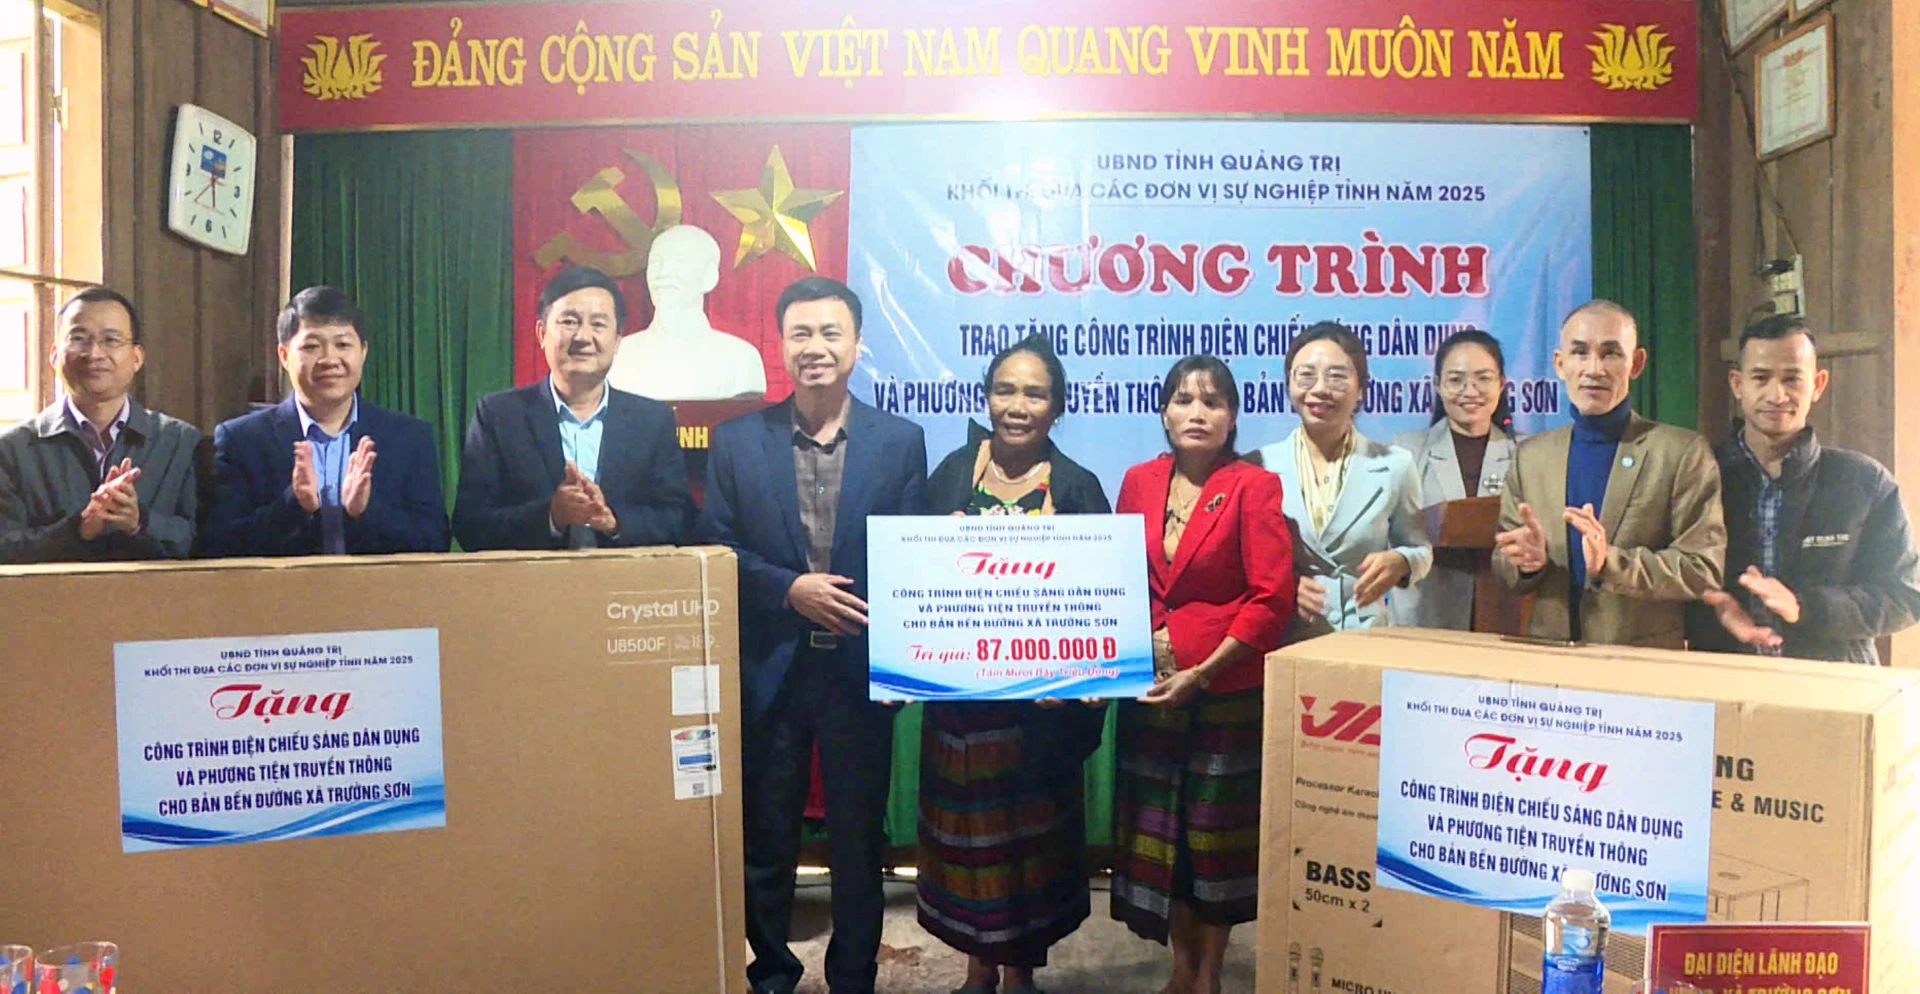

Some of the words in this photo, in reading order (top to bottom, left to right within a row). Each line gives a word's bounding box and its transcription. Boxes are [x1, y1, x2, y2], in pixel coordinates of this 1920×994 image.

[412, 17, 526, 87] ĐẢNG
[540, 20, 657, 95] CỘNG
[672, 9, 760, 80] SẢN
[780, 15, 889, 88] VIỆT
[902, 26, 1001, 77] NAM
[1017, 24, 1172, 78] QUANG
[1185, 26, 1309, 77] VINH
[1326, 15, 1453, 80] MUÔN
[1467, 16, 1564, 80] NĂM
[1097, 155, 1157, 171] UBND
[1164, 151, 1213, 171] TỈNH
[1220, 151, 1303, 171] QUẢNG
[1310, 156, 1340, 175] TRỊ
[1090, 180, 1138, 200] CÁC
[1145, 183, 1191, 200] ĐƠN
[1198, 184, 1217, 204] VỊ
[1224, 183, 1250, 204] SỰ
[1254, 180, 1330, 204] NGHIỆP
[1335, 180, 1380, 201] TỈNH
[1386, 180, 1433, 201] NĂM
[1438, 185, 1486, 201] 2025
[948, 234, 1249, 293] CHƯƠNG
[1268, 230, 1488, 294] TRÌNH
[960, 324, 1010, 356] TRAO
[1075, 317, 1129, 356] CÔNG
[1135, 318, 1194, 356] TRÌNH
[1200, 318, 1248, 363] ĐIỆN
[1378, 318, 1418, 356] DÂN
[874, 376, 898, 412] VÀ
[904, 380, 986, 413] PHƯƠNG
[1244, 372, 1284, 414] BẢN
[1522, 378, 1558, 414] SƠN
[957, 552, 1057, 580] Tặng
[607, 600, 678, 623] Crystal
[220, 650, 250, 660] UBND
[326, 646, 342, 656] TRỊ
[976, 637, 1098, 661] 87.000.000
[1103, 636, 1117, 660] Đ
[210, 684, 354, 724] Tặng
[1478, 696, 1508, 707] UBND
[1586, 707, 1602, 718] TRỊ
[144, 741, 184, 761] CÔNG
[187, 738, 228, 758] TRÌNH
[232, 735, 265, 757] ĐIỆN
[268, 730, 309, 753] CHIẾU
[314, 730, 349, 750] SÁNG
[353, 728, 380, 747] DÂN
[384, 729, 420, 748] DỤNG
[177, 766, 194, 786] VÀ
[199, 766, 256, 785] PHƯƠNG
[259, 761, 290, 782] TIỆN
[294, 755, 345, 778] TRUYỀN
[349, 754, 392, 774] THÔNG
[1464, 732, 1610, 792] Tặng
[159, 799, 187, 816] CHO
[192, 794, 220, 813] BẢN
[224, 789, 252, 811] BẾN
[256, 789, 302, 808] ĐƯỜNG
[306, 786, 324, 804] XÃ
[328, 783, 380, 803] TRƯỜNG
[384, 783, 411, 798] SƠN
[1400, 778, 1436, 801] CÔNG
[1440, 785, 1478, 808] TRÌNH
[1482, 791, 1514, 815] ĐIỆN
[1518, 795, 1559, 820] CHIẾU
[1564, 802, 1602, 827] SÁNG
[1606, 809, 1637, 832] DÂN
[1641, 816, 1683, 839] DỤNG
[1730, 792, 1744, 812] &
[1754, 796, 1824, 824] MUSIC
[1428, 811, 1444, 833] VÀ
[1448, 818, 1502, 842] PHƯƠNG
[1506, 825, 1537, 849] TIỆN
[1541, 832, 1594, 857] TRUYỀN
[1599, 841, 1648, 866] THÔNG
[1306, 860, 1372, 892] BASS
[1410, 841, 1434, 860] CHO
[1438, 843, 1466, 865] BẢN
[1470, 846, 1496, 871] BẾN
[1500, 855, 1547, 880] ĐƯỜNG
[1636, 879, 1666, 900] SƠN
[1305, 888, 1344, 908] 50cm
[1362, 900, 1370, 912] 2
[1684, 952, 1712, 979] ĐẠI
[1716, 948, 1754, 979] DIỆN
[1758, 948, 1800, 974] LÃNH
[1805, 952, 1838, 979] ĐẠO
